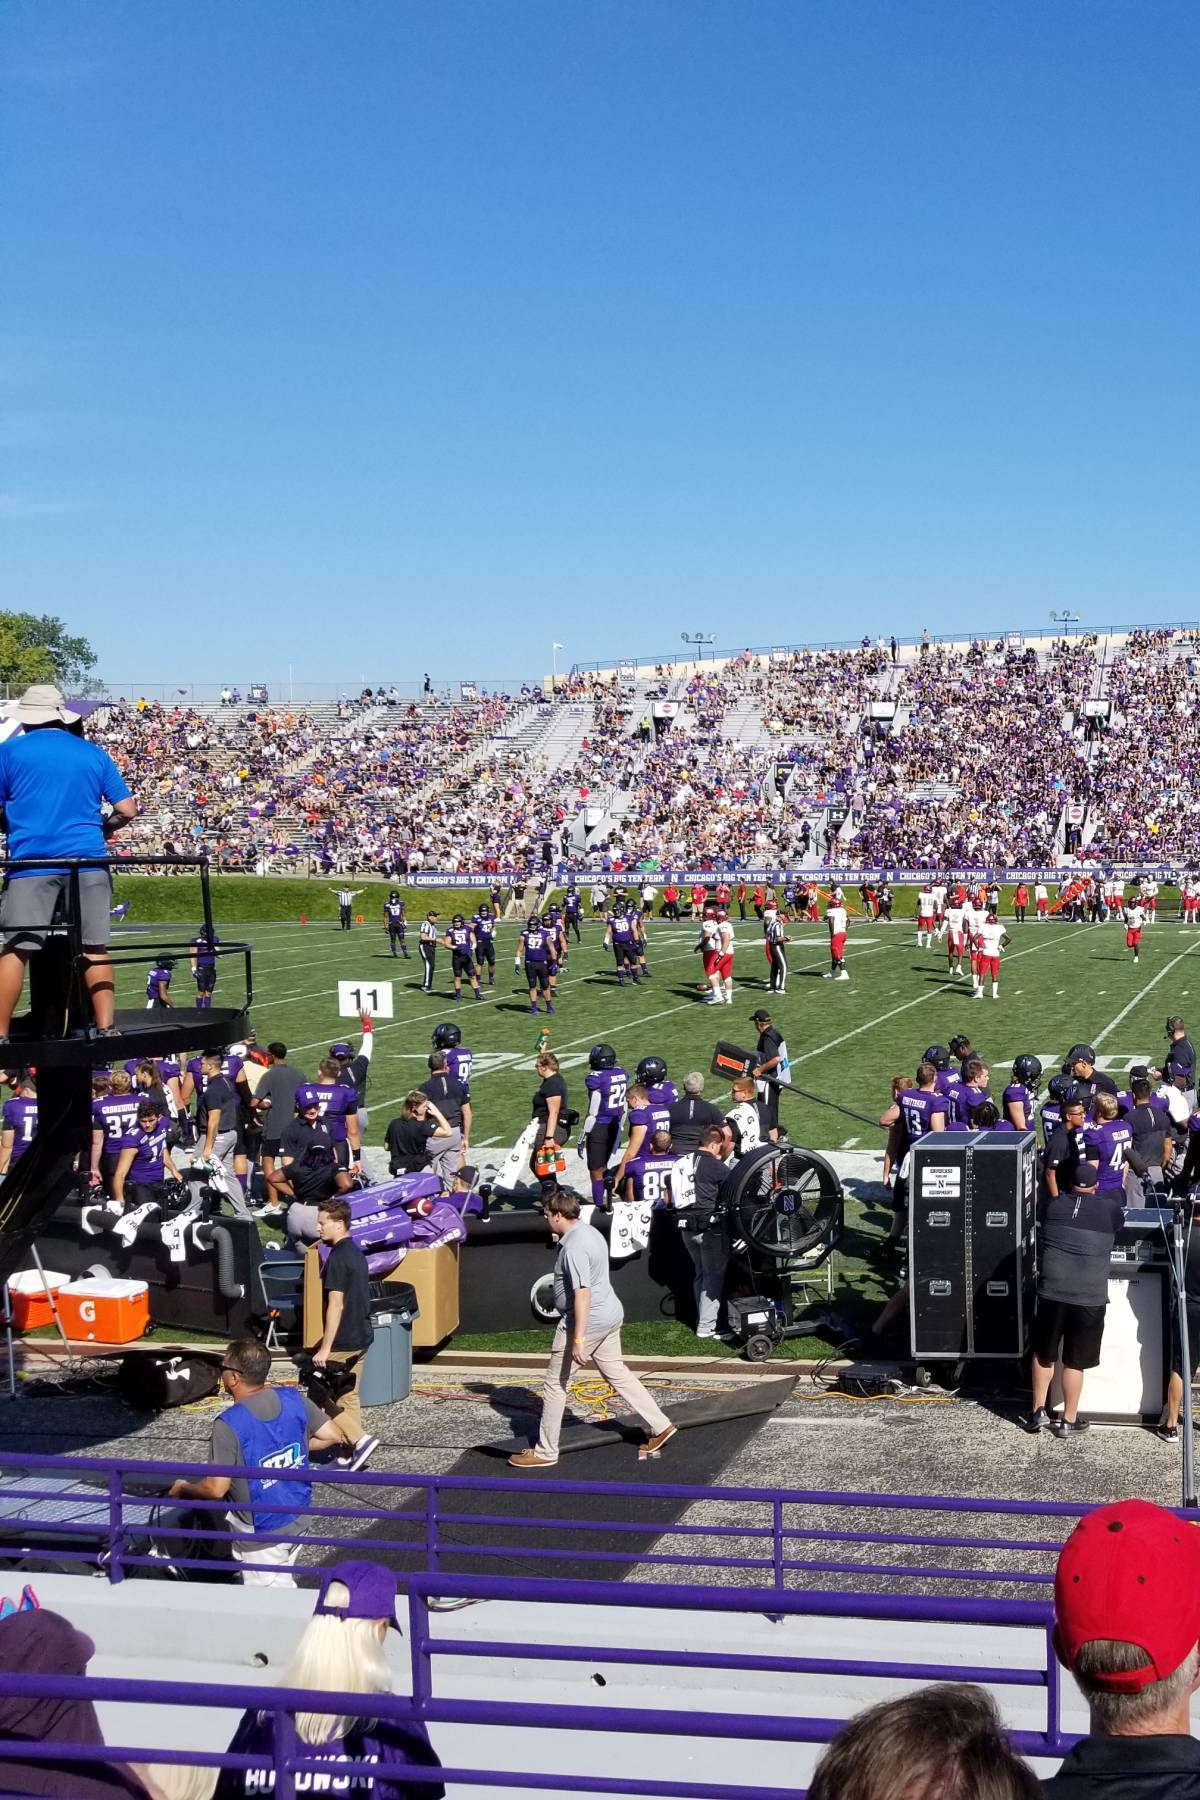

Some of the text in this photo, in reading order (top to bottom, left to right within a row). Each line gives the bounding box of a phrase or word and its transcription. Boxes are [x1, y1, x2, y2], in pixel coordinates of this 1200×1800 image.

[416, 876, 455, 884] CHICAGO'S
[456, 876, 468, 884] BIG
[470, 876, 486, 884] TEN
[684, 874, 721, 882] CHICAGO'S
[722, 874, 736, 882] BIG
[793, 873, 829, 881] CHICAGO'S
[831, 873, 843, 881] BIG
[844, 873, 858, 881] TEN
[860, 873, 880, 881] TEAM
[1006, 871, 1042, 879] CHICAGO'S
[1044, 871, 1056, 879] BIG
[615, 922, 629, 933] 90
[528, 938, 542, 949] 97
[350, 988, 378, 1011] 11
[717, 1054, 744, 1072] 1
[608, 1084, 627, 1109] 22
[106, 1113, 137, 1138] 37
[904, 1107, 922, 1135] 13
[938, 1180, 944, 1188] N
[784, 1195, 794, 1211] N
[79, 1301, 96, 1321] G
